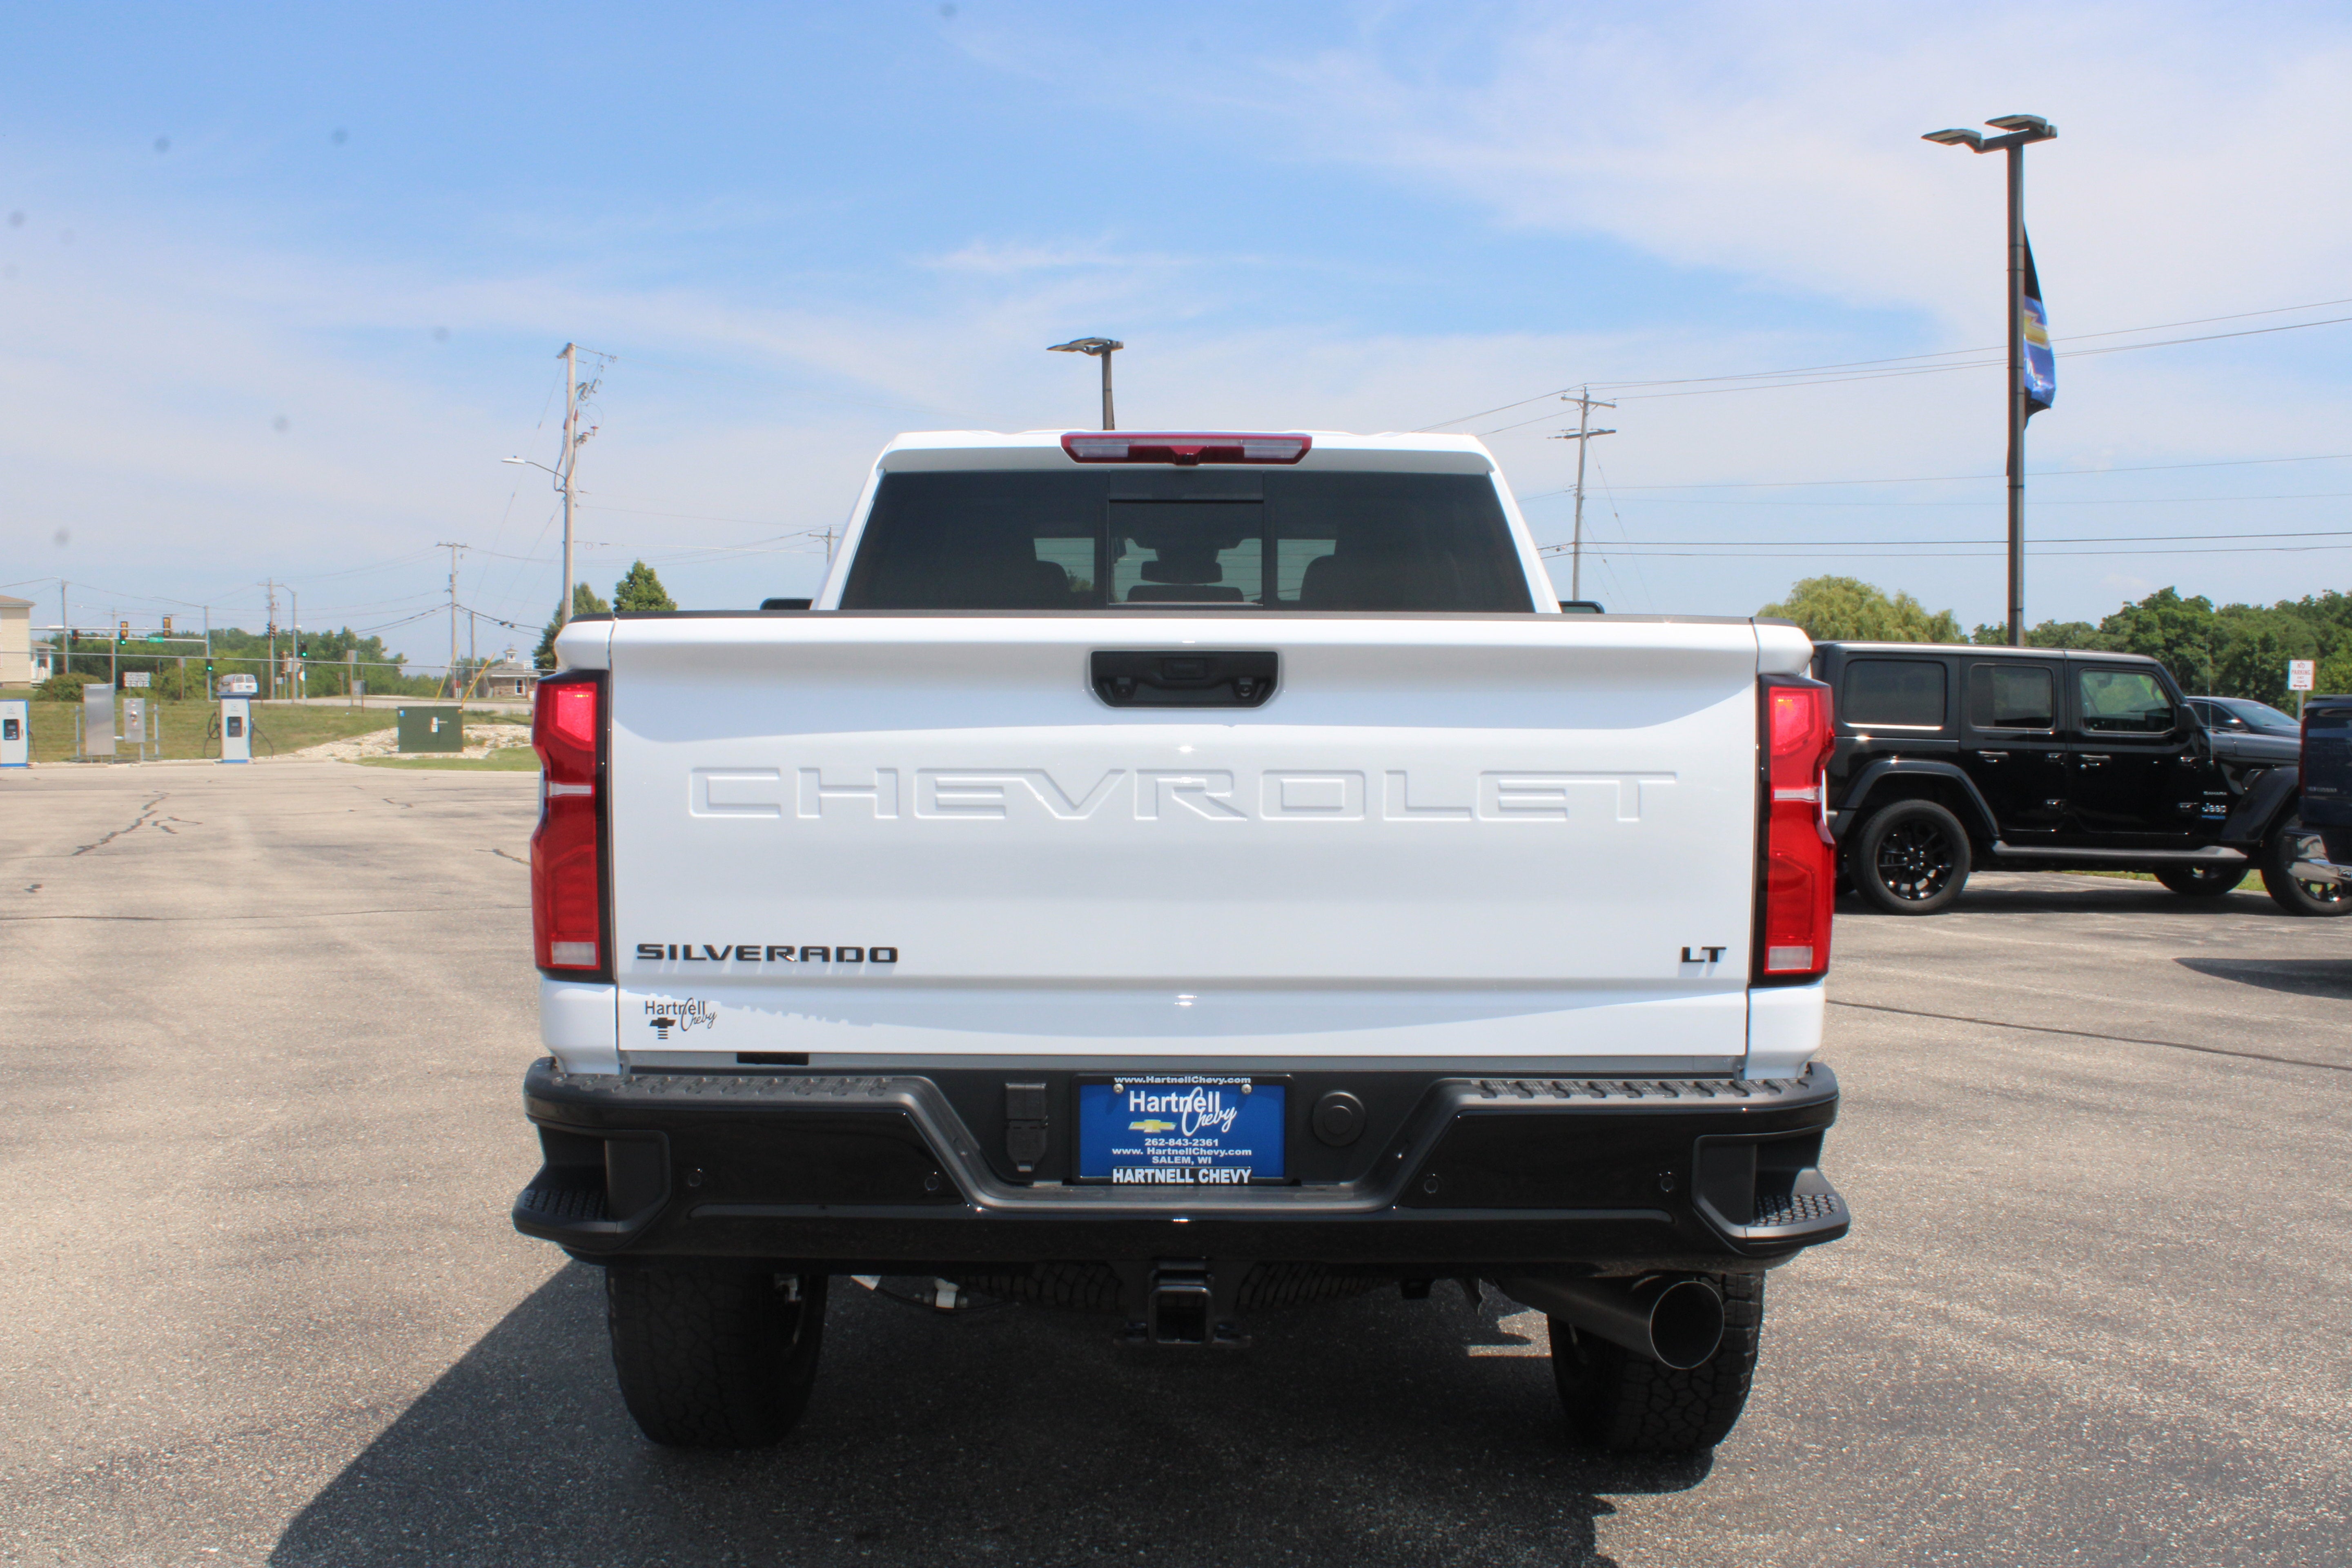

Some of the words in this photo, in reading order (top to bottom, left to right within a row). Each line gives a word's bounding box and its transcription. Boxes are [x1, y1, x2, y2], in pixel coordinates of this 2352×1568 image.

[690, 767, 1677, 822] CHEVROLET
[2202, 803, 2227, 814] Jeep
[637, 944, 898, 963] SILVERADO
[1682, 947, 1727, 962] LT
[645, 1000, 705, 1015] Hartnell
[681, 997, 717, 1031] Chevy
[1114, 1076, 1252, 1085] www.HartnellChevy.com
[1129, 1090, 1220, 1112] Hartnell
[1181, 1086, 1237, 1136] Chevy
[1145, 1138, 1219, 1147] 262-843-2361
[1152, 1156, 1194, 1165] SALEM,
[1112, 1168, 1194, 1183] HARTNELL
[1198, 1168, 1252, 1183] CHEVY
